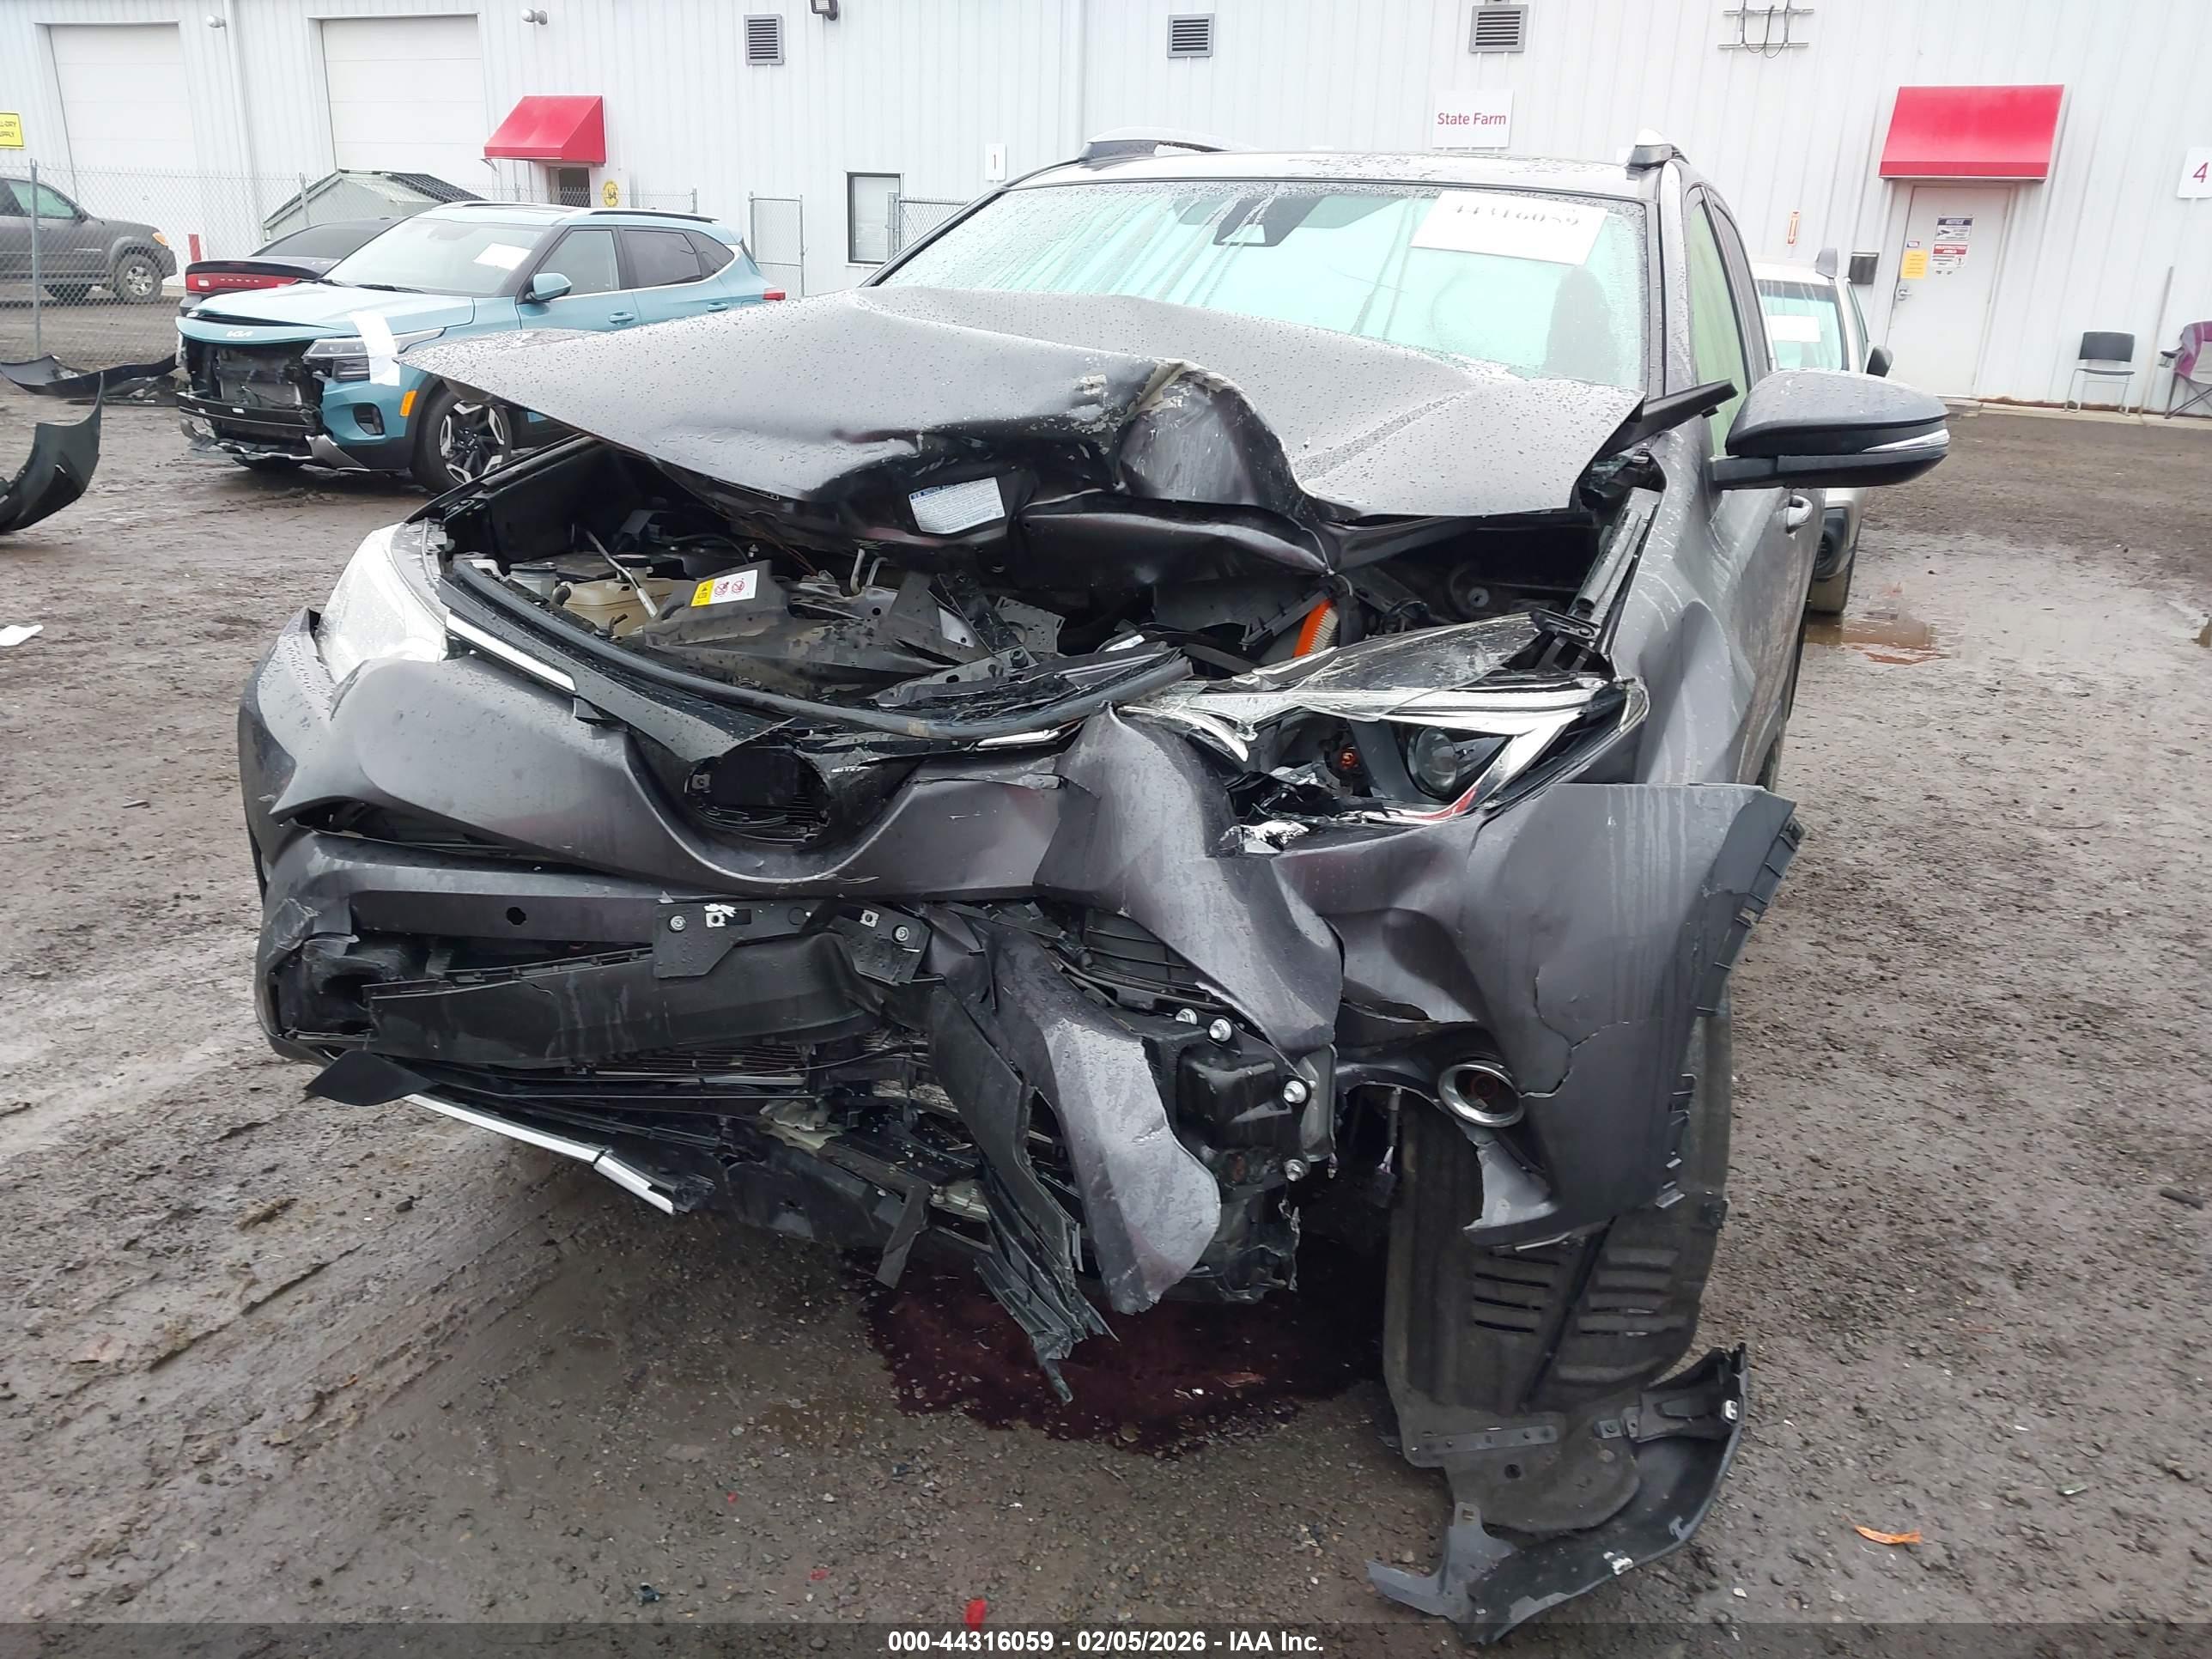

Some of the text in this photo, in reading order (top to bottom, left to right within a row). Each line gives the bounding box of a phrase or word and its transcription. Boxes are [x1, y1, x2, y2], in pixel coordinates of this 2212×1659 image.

[1437, 112, 1506, 125] State Farm
[2192, 162, 2209, 183] 4
